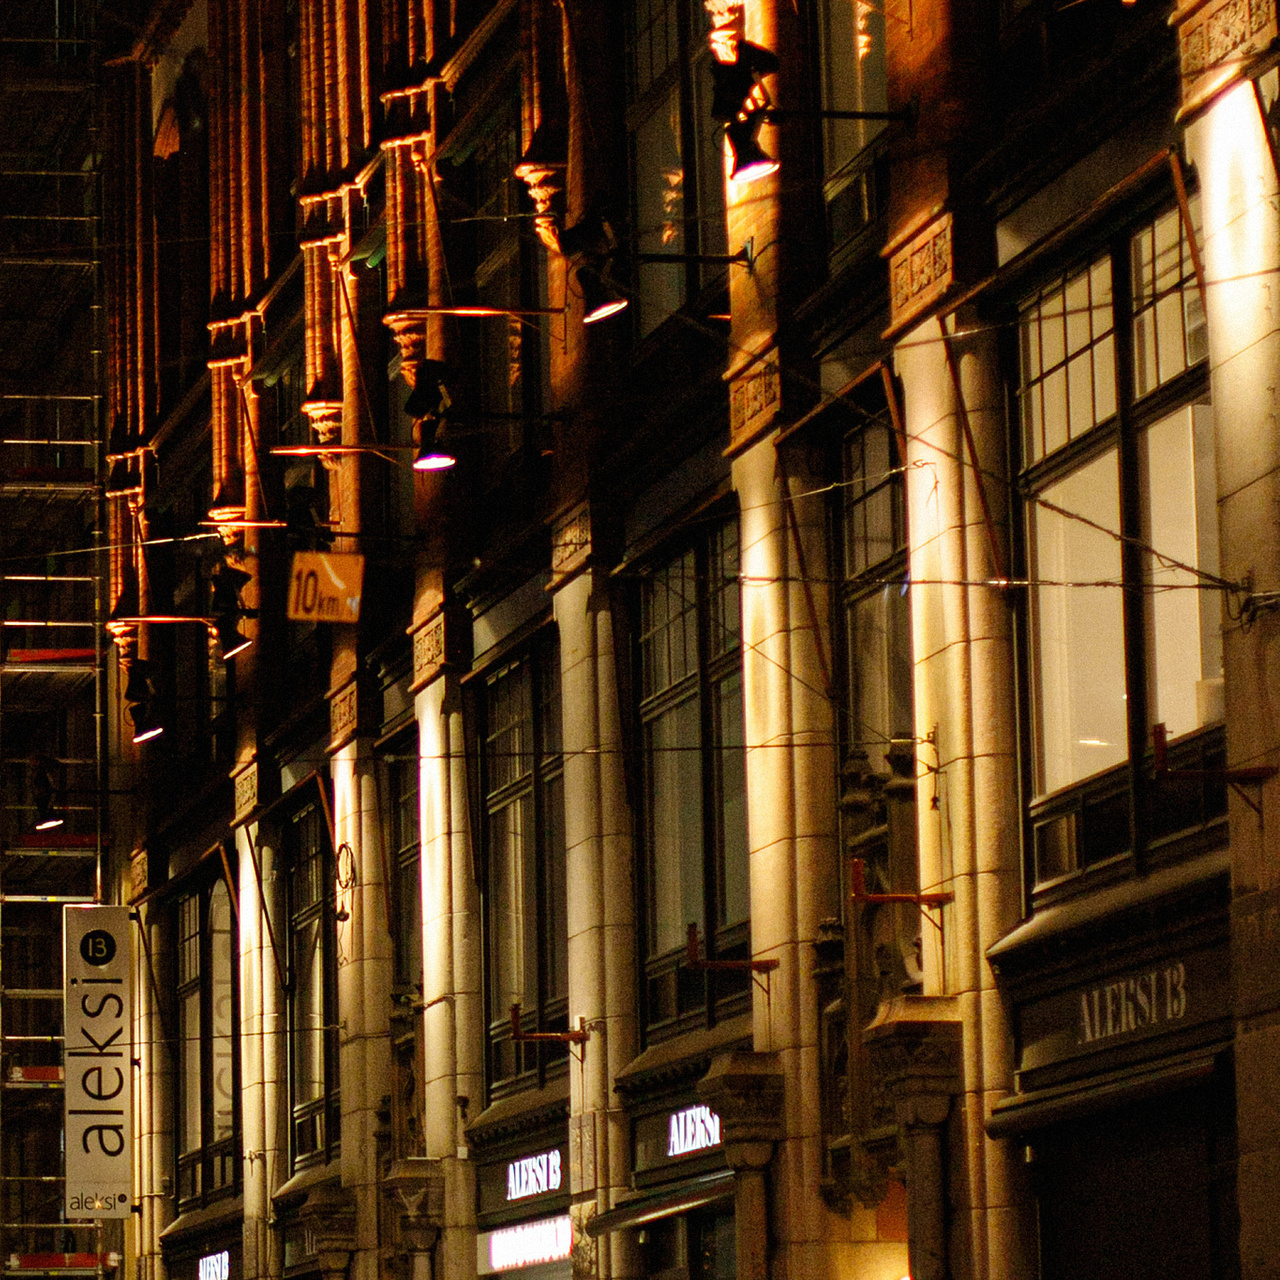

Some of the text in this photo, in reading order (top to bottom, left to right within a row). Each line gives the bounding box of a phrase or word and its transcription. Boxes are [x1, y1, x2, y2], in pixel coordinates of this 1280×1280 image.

[293, 569, 319, 615] 10
[87, 937, 108, 958] 13
[1076, 961, 1188, 1046] ALEKSI 13
[67, 976, 125, 1157] aleksi
[506, 1148, 562, 1201] ALEKSI 13
